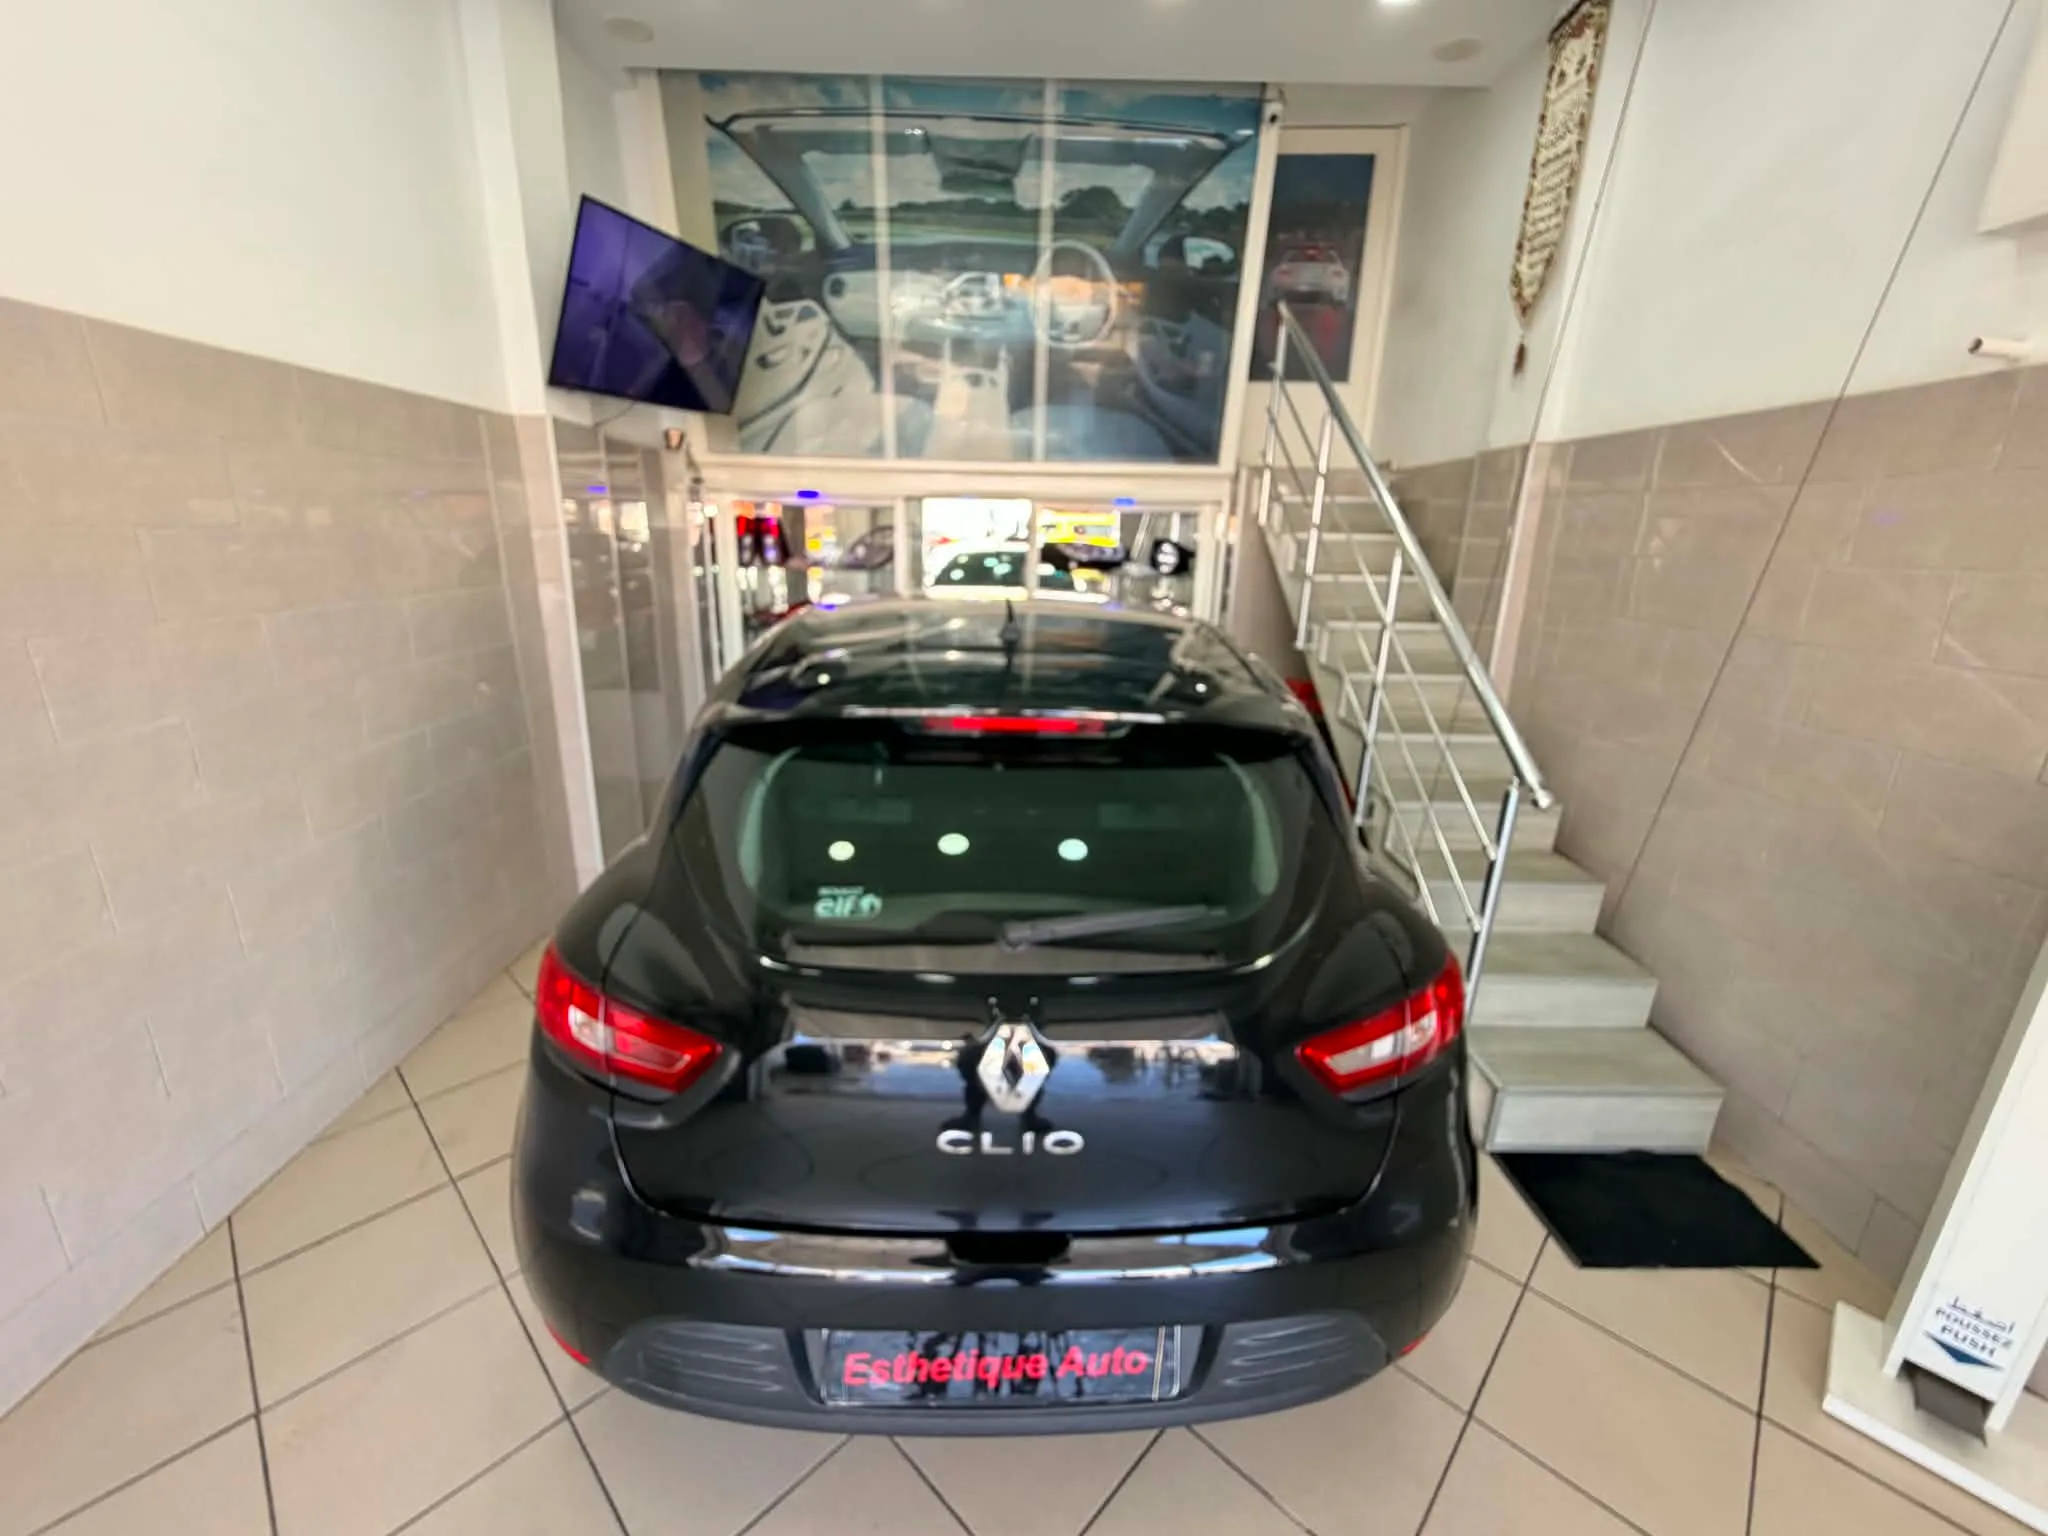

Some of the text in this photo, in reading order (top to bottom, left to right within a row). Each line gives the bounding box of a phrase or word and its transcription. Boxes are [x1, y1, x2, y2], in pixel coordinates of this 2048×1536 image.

[936, 1129, 1085, 1156] CLIO
[1935, 1307, 2013, 1349] POUSSEZ
[1940, 1324, 1997, 1357] PUSH
[843, 1345, 1148, 1388] Esthetique Auto
